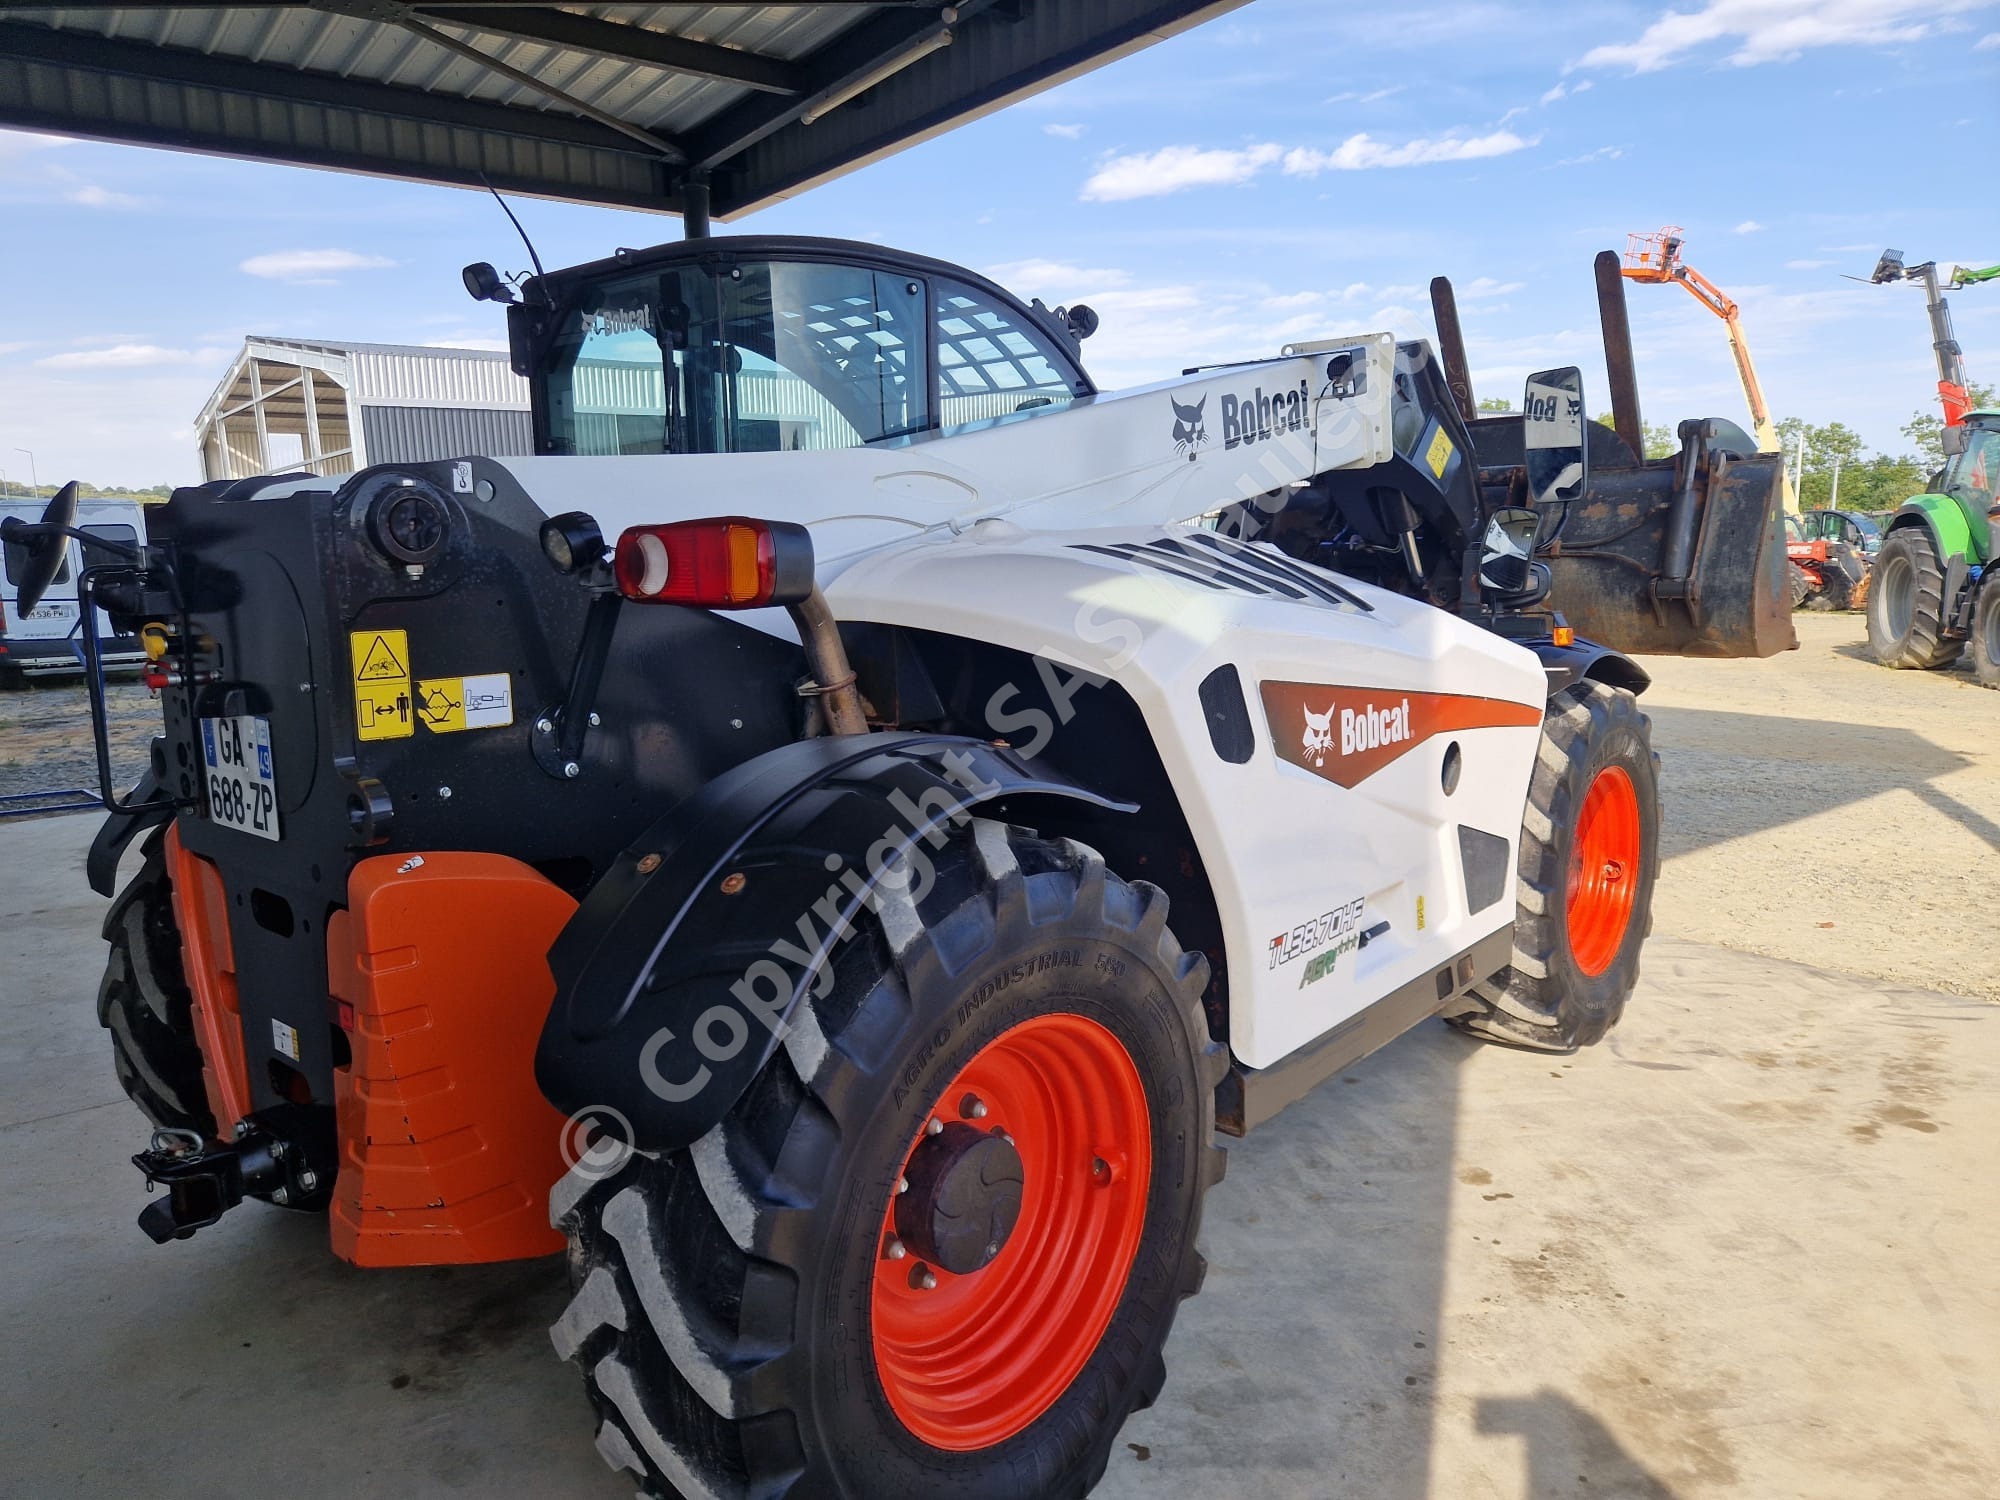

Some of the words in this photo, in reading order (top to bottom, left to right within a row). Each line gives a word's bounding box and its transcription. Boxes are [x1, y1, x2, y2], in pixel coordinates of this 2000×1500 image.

[603, 304, 651, 336] Bobcat
[1221, 379, 1311, 451] Bobcat
[1341, 698, 1410, 756] Bobcat
[259, 751, 271, 775] 49
[210, 773, 274, 833] 688-ZP
[1269, 896, 1366, 971] TL38.70HF
[894, 1026, 952, 1112] AGRO
[957, 950, 1084, 1027] INDUSTRIAL
